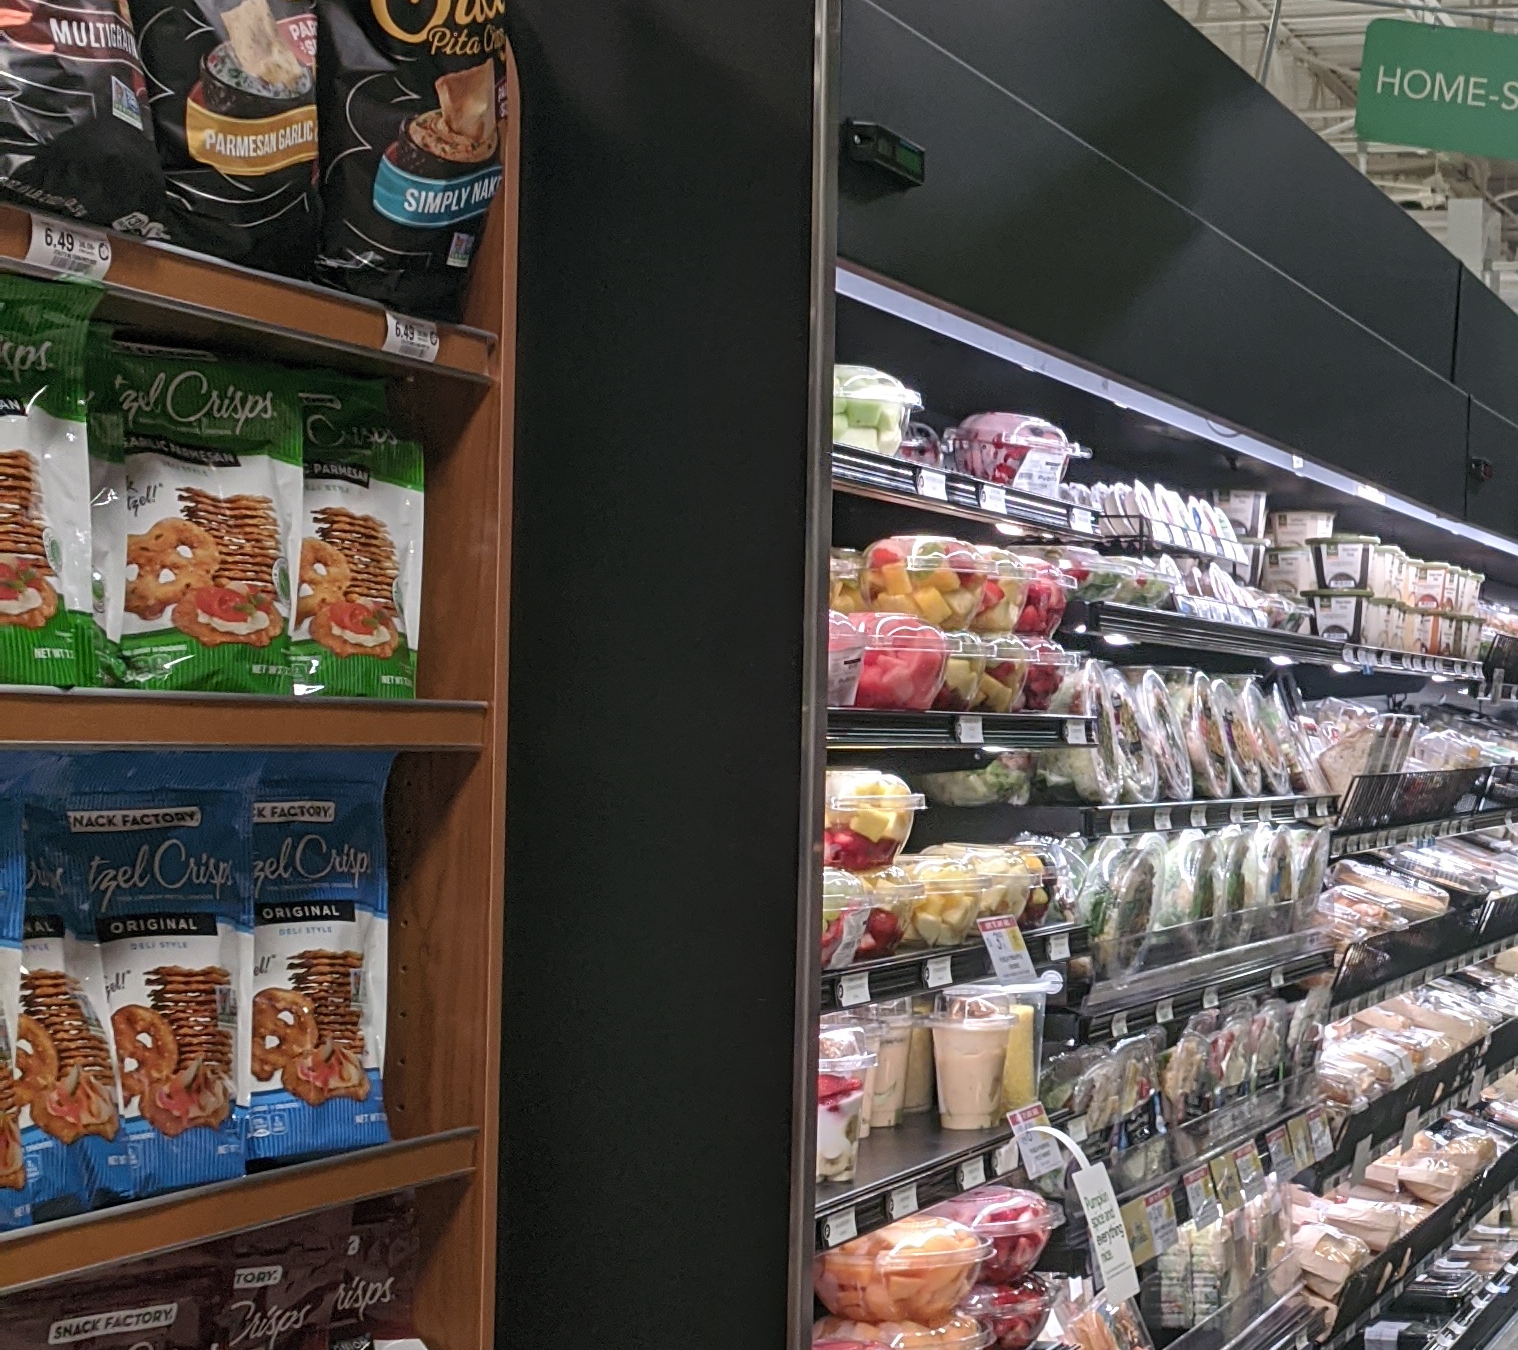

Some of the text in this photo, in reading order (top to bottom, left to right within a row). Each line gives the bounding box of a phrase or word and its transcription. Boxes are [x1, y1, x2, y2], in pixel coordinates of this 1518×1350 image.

[428, 27, 480, 55] Pita
[205, 120, 313, 157] PARMESAN GARLIC
[404, 180, 469, 214] SIMPLY
[44, 227, 74, 252] 6.49
[396, 321, 414, 340] 6.49
[166, 371, 273, 435] Crisps
[122, 809, 197, 827] FACTORY
[271, 805, 330, 818] FACTORY
[262, 904, 340, 919] ORIGINAL
[110, 917, 198, 934] ORIGINAL
[235, 1270, 274, 1284] TORY
[53, 1309, 172, 1340] SNACK FACTORY
